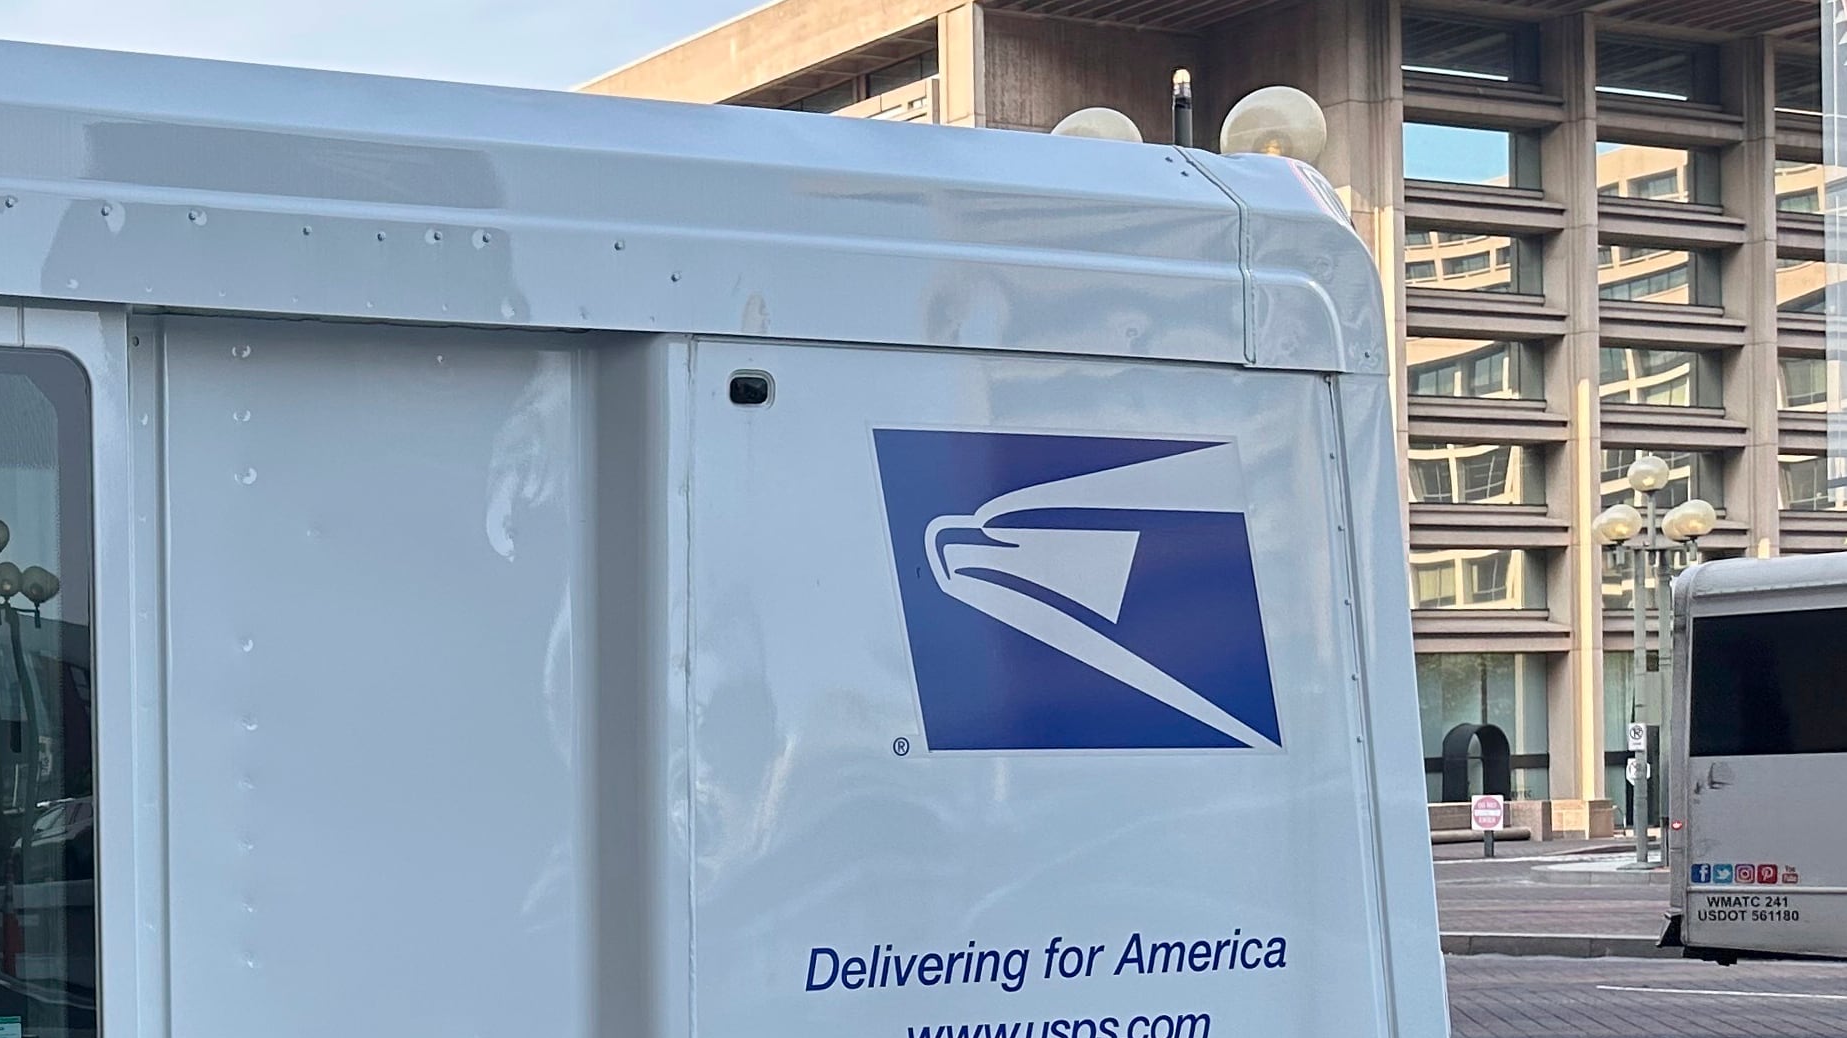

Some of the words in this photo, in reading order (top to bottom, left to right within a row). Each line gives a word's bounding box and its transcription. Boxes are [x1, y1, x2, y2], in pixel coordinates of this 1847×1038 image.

[1707, 896, 1760, 907] WMATC
[1765, 896, 1788, 907] 241
[1698, 910, 1747, 921] USDOT
[1751, 910, 1799, 921] 561180
[806, 940, 1030, 992] Delivering
[1044, 936, 1105, 979] for
[1113, 928, 1287, 976] America
